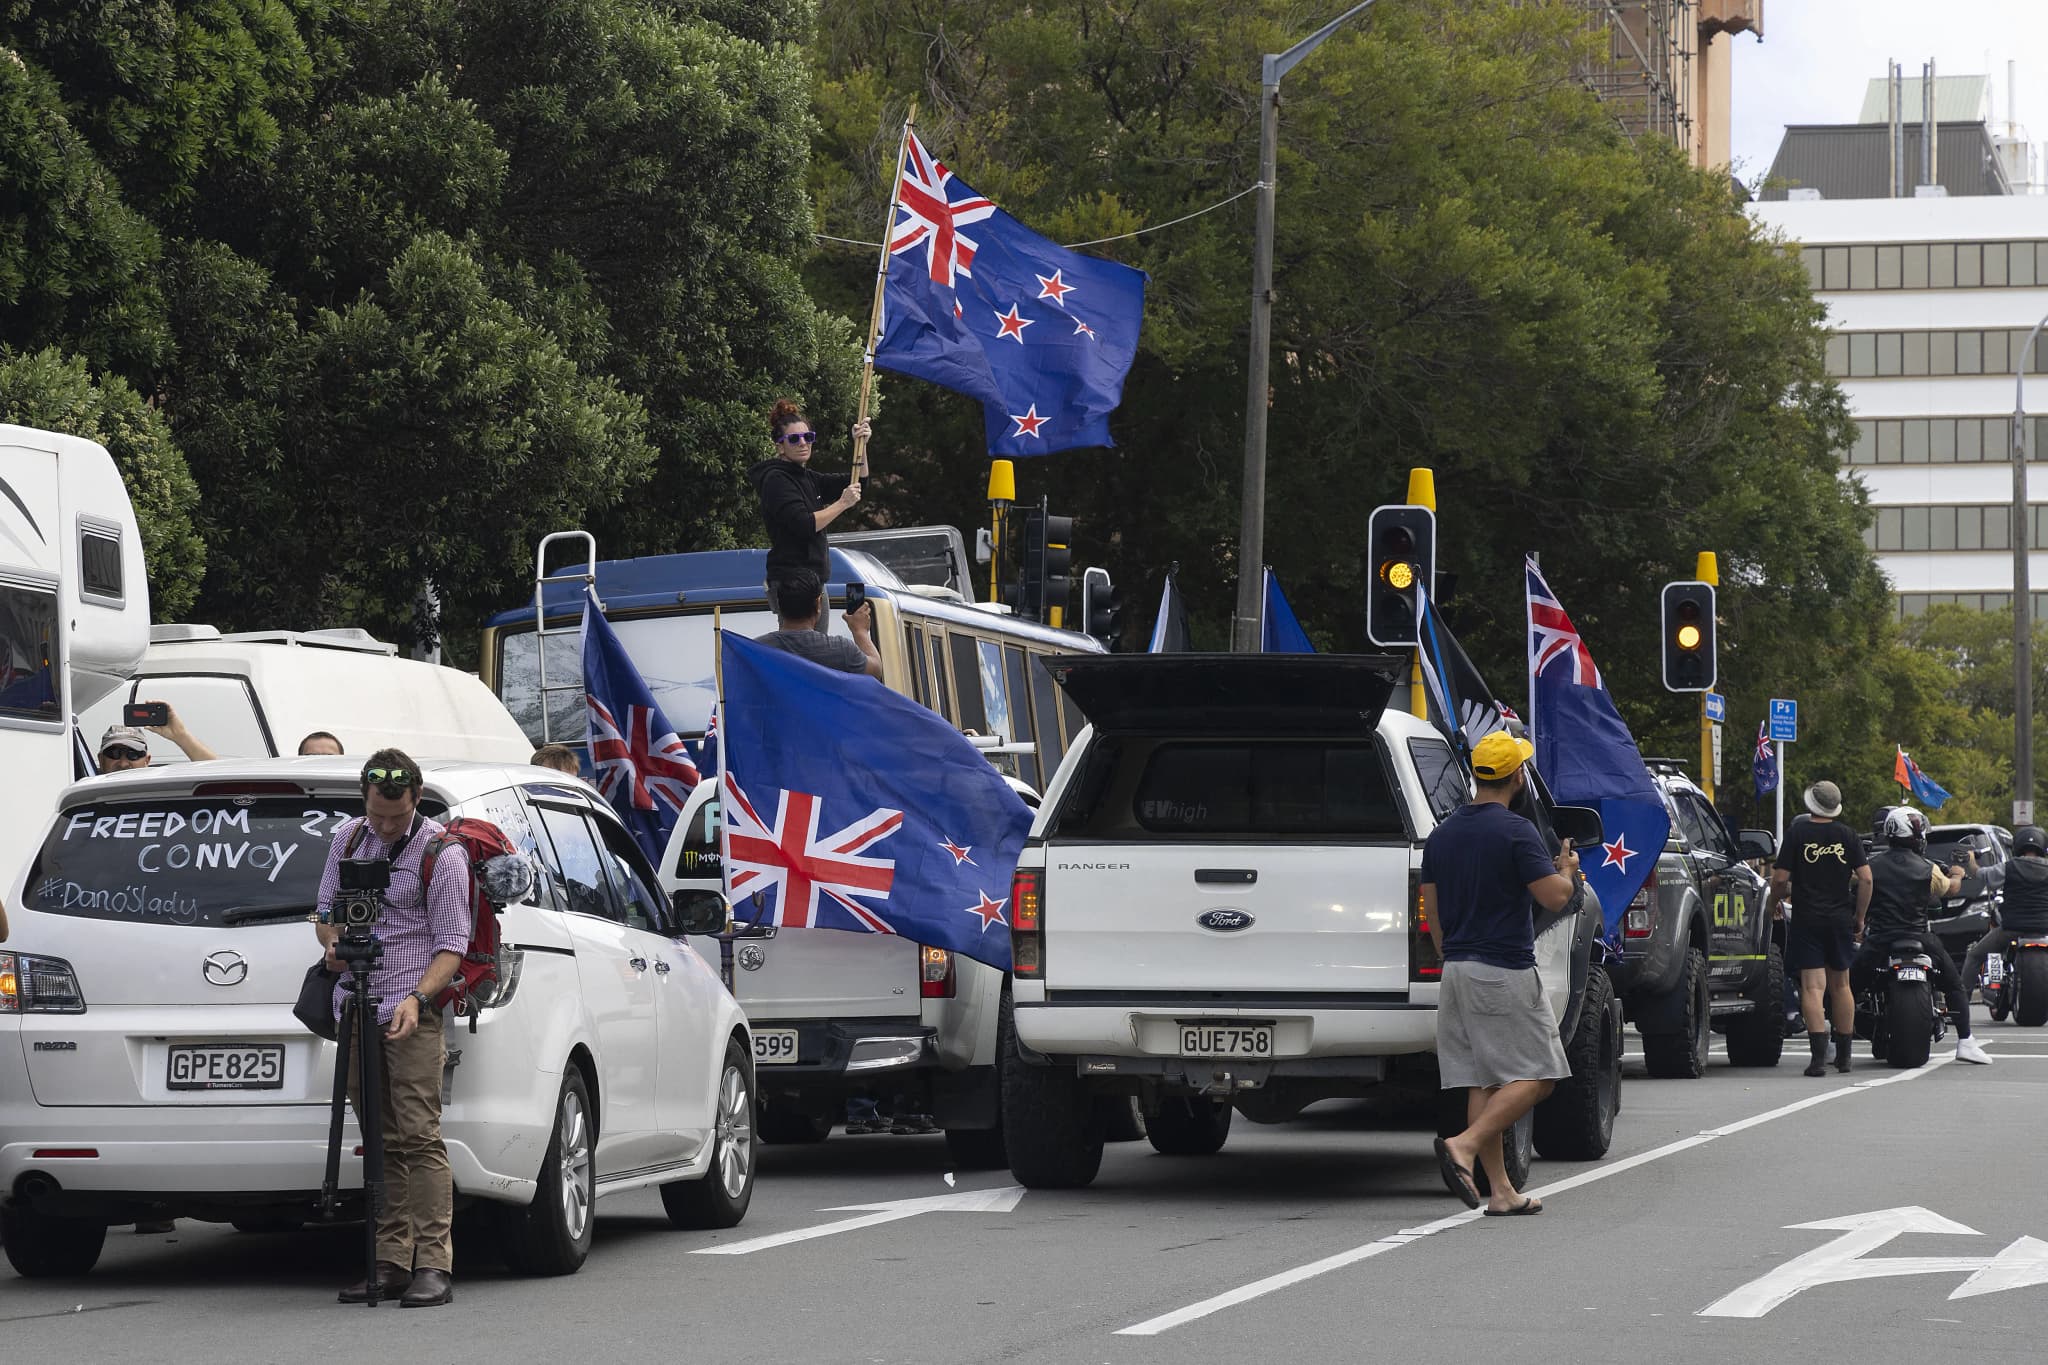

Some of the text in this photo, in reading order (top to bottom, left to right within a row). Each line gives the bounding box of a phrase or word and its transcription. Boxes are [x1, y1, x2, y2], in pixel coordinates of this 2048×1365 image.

[63, 808, 250, 840] FREEDOM
[138, 841, 298, 882] CONVOY
[1209, 912, 1241, 926] Ford
[1714, 894, 1745, 926] CLR
[752, 1036, 794, 1056] 599
[1184, 1030, 1269, 1053] GUE758
[173, 1053, 277, 1079] GPE825
